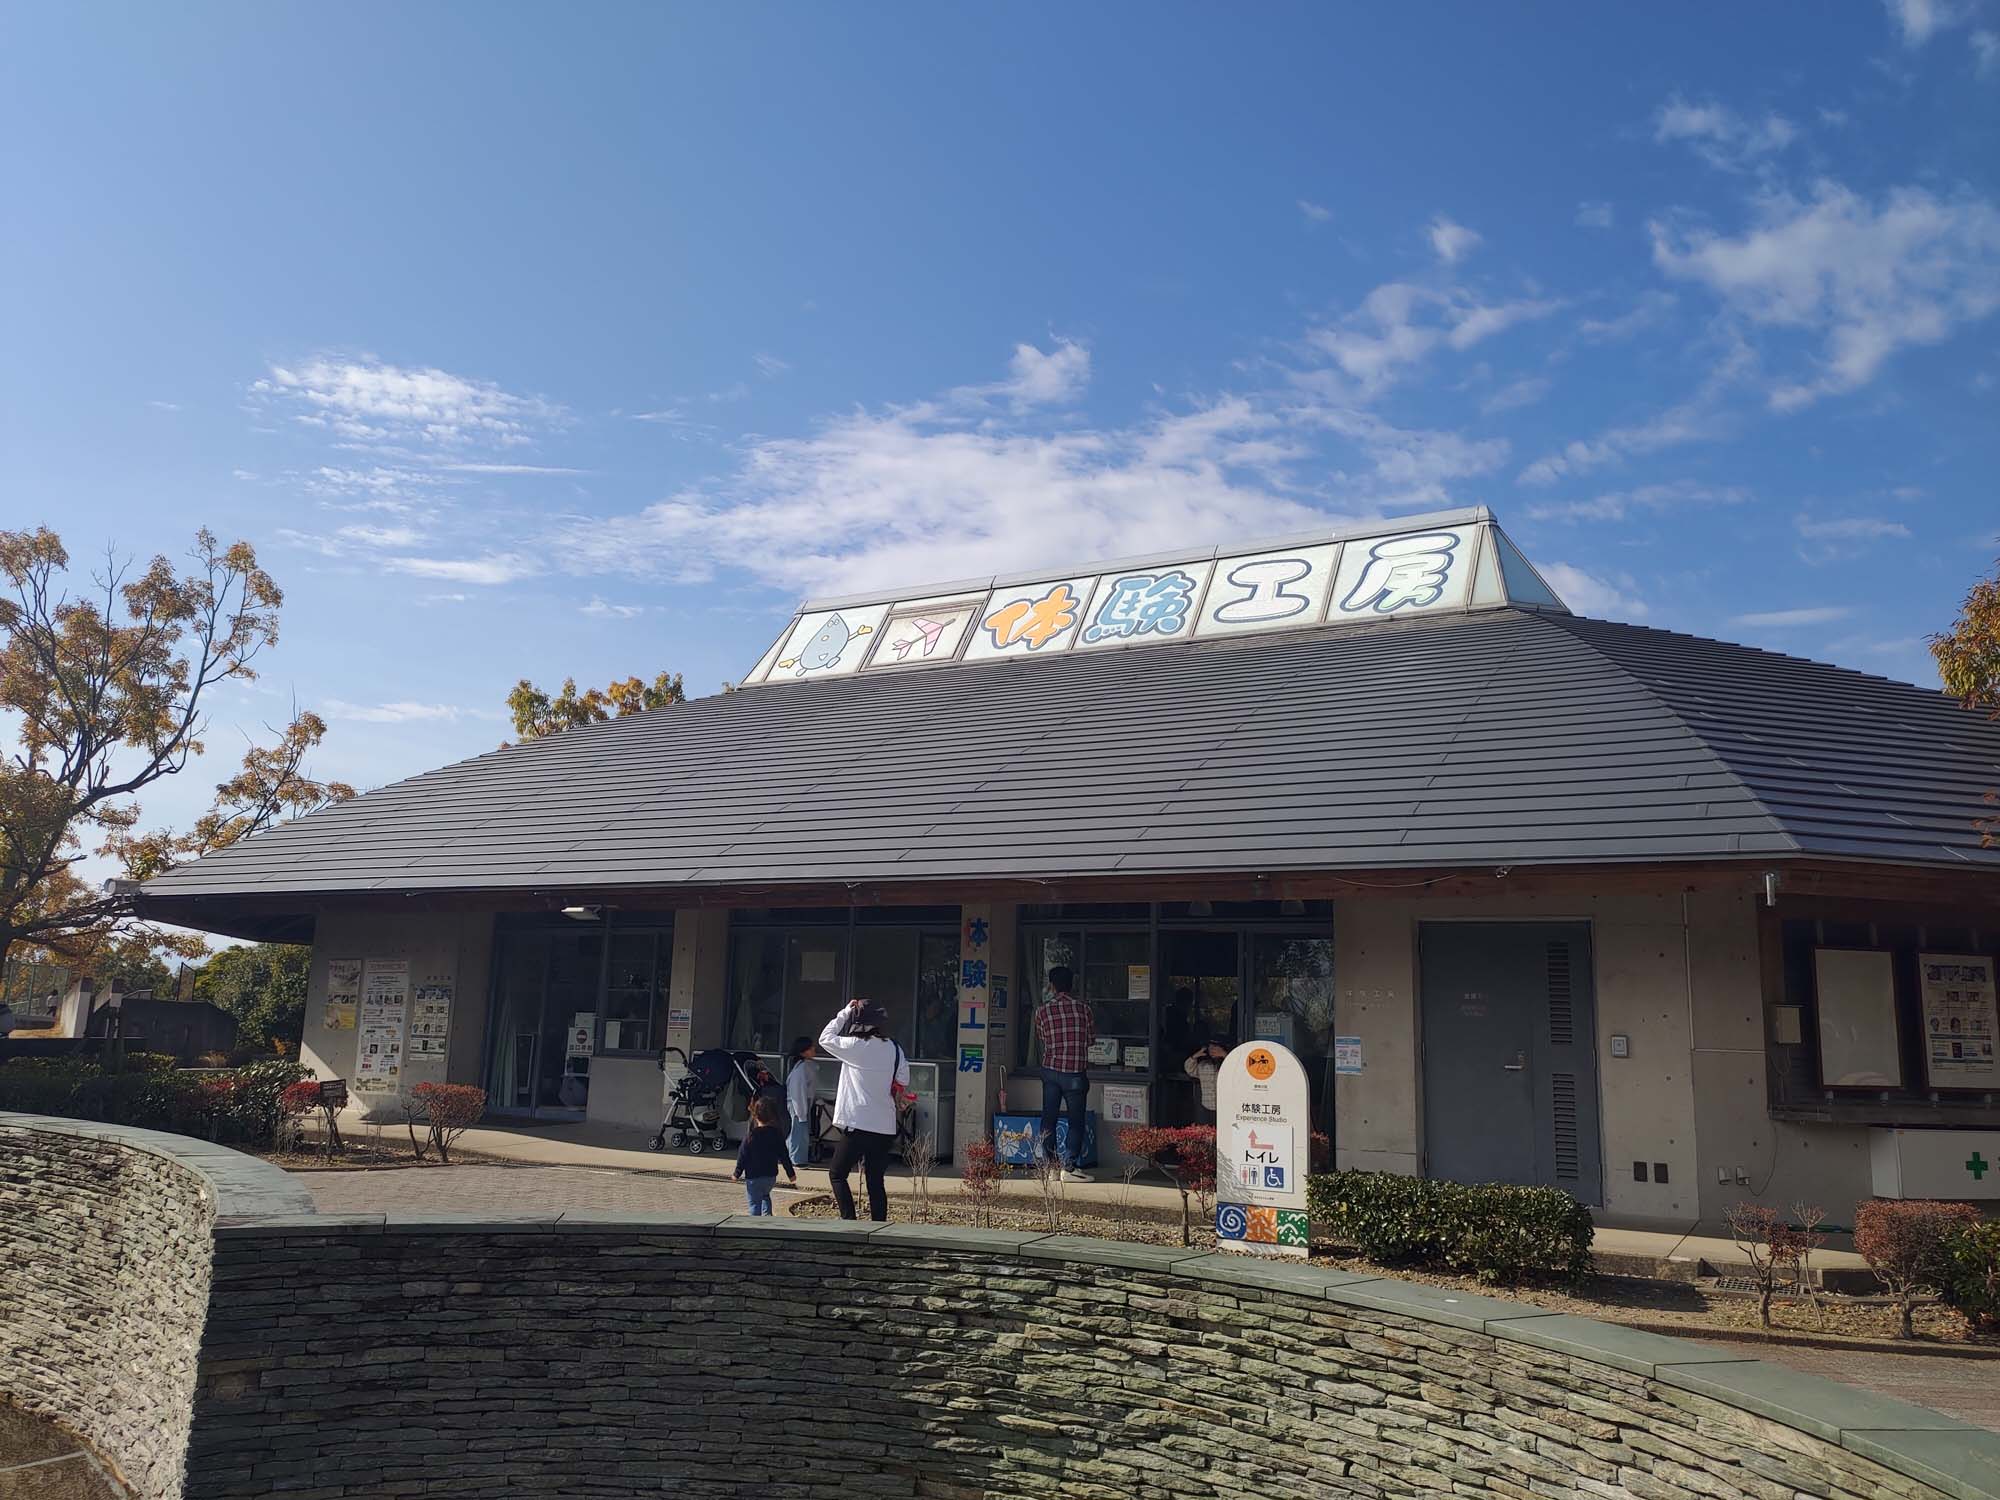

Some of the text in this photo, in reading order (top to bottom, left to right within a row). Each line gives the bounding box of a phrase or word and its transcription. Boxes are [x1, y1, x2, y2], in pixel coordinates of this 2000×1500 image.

[982, 531, 1460, 652] 体験工房
[1241, 1103, 1281, 1115] 体験工房
[1236, 1114, 1267, 1122] Experience
[1245, 1150, 1279, 1164] トイレ
